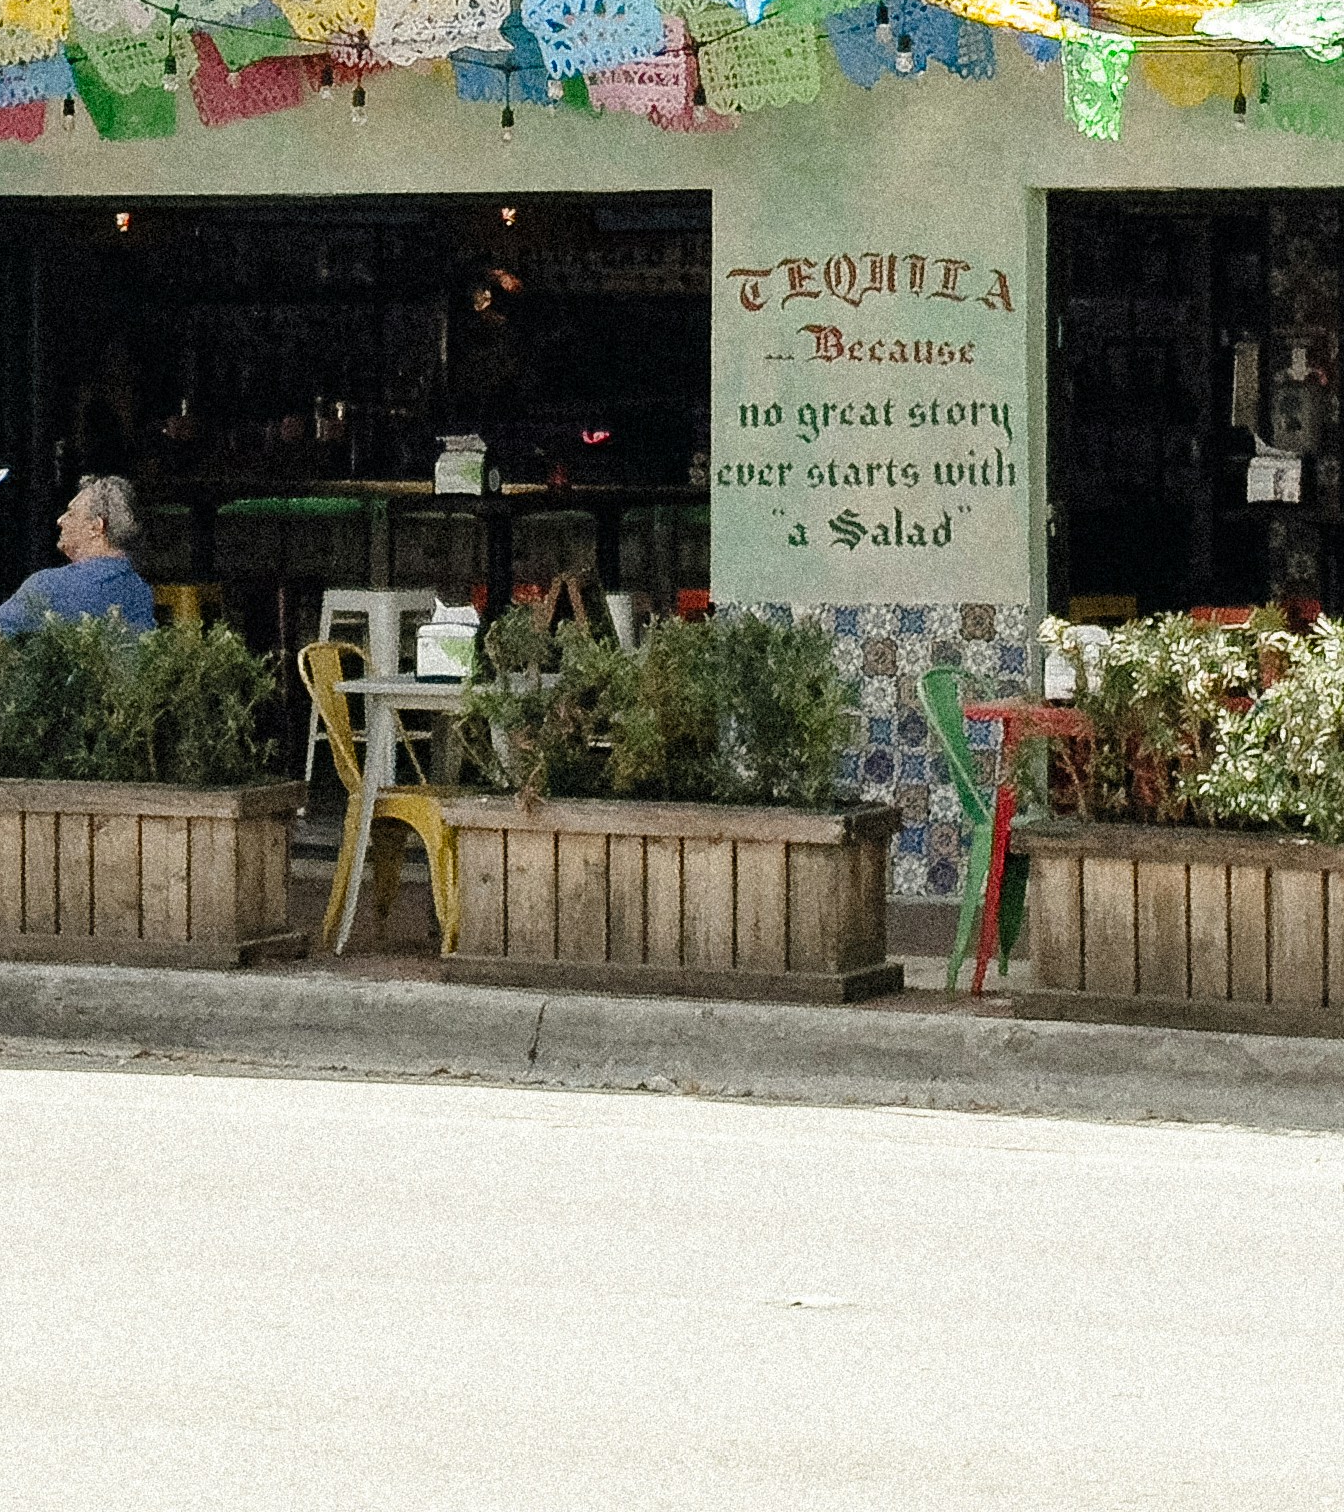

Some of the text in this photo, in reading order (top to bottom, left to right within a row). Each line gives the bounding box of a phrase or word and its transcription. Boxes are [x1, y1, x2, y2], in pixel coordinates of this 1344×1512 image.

[726, 252, 1015, 312] TEQUILA
[740, 399, 1013, 443] no great story
[717, 447, 1016, 488] ever starts with
